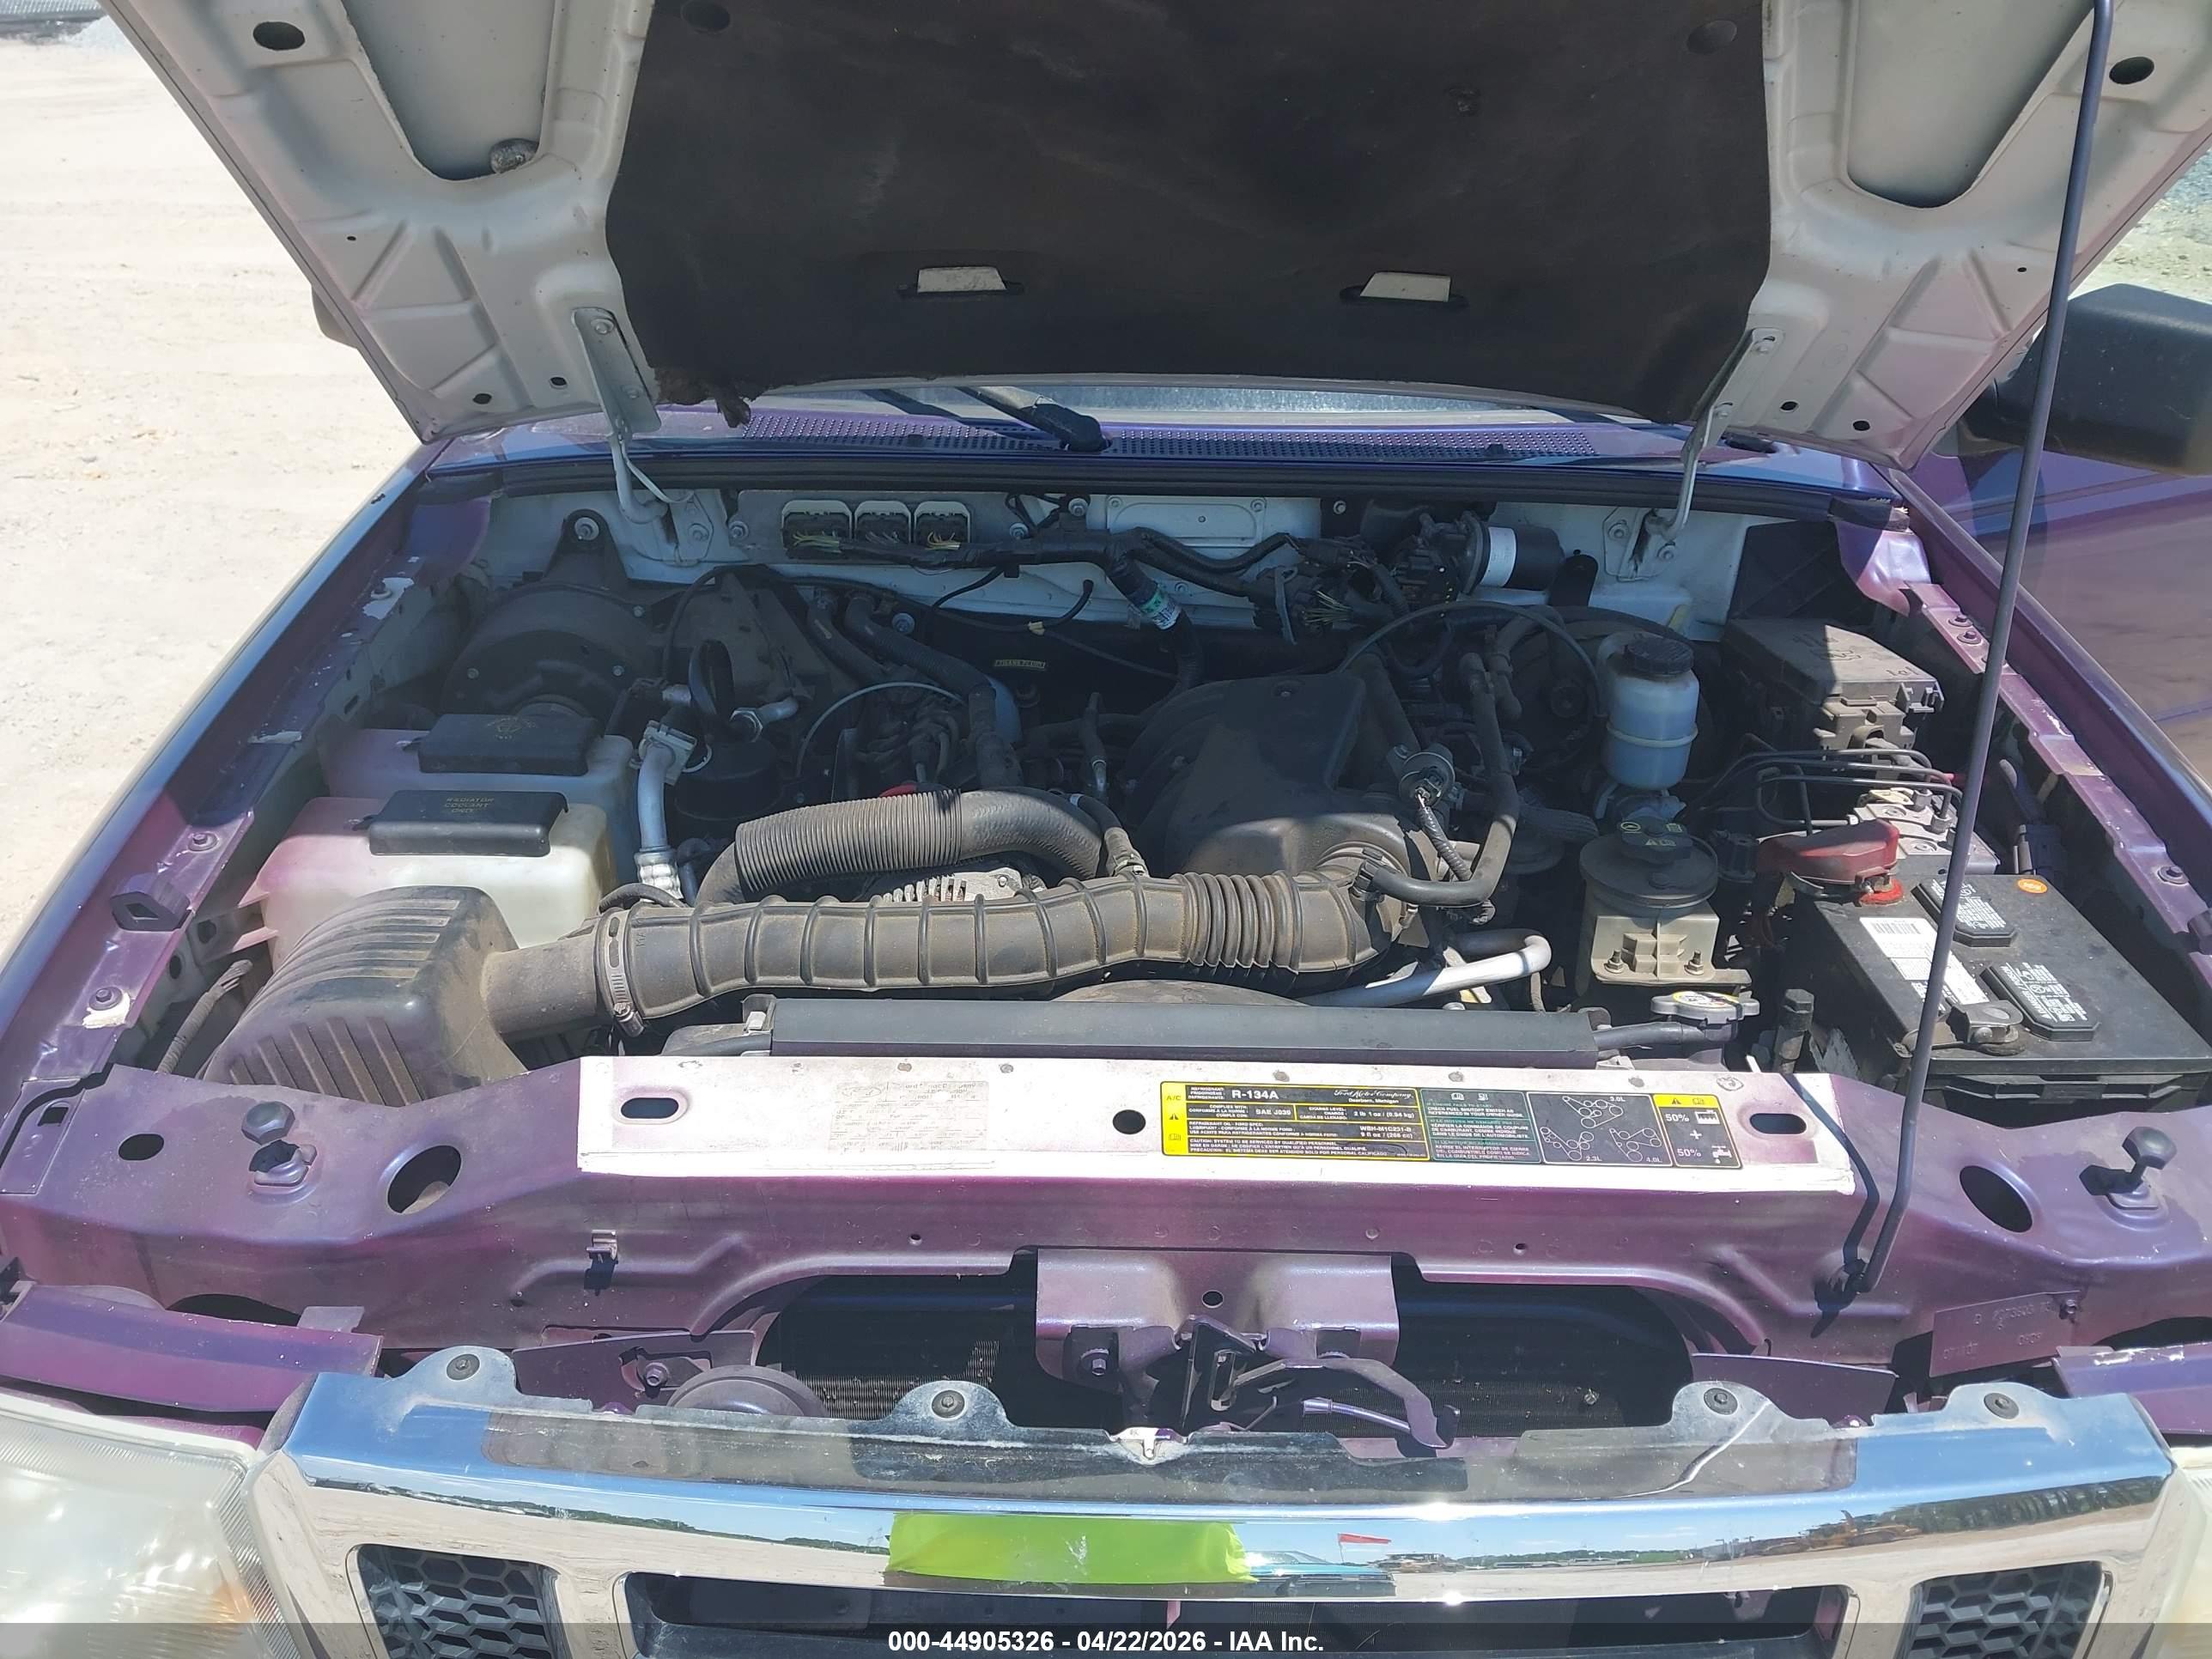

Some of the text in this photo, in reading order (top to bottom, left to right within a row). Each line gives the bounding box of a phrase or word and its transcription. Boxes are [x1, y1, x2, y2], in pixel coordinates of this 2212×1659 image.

[1231, 1089, 1279, 1100] R-134A
[1665, 1113, 1690, 1122] 50%
[1677, 1148, 1702, 1158] 50%
